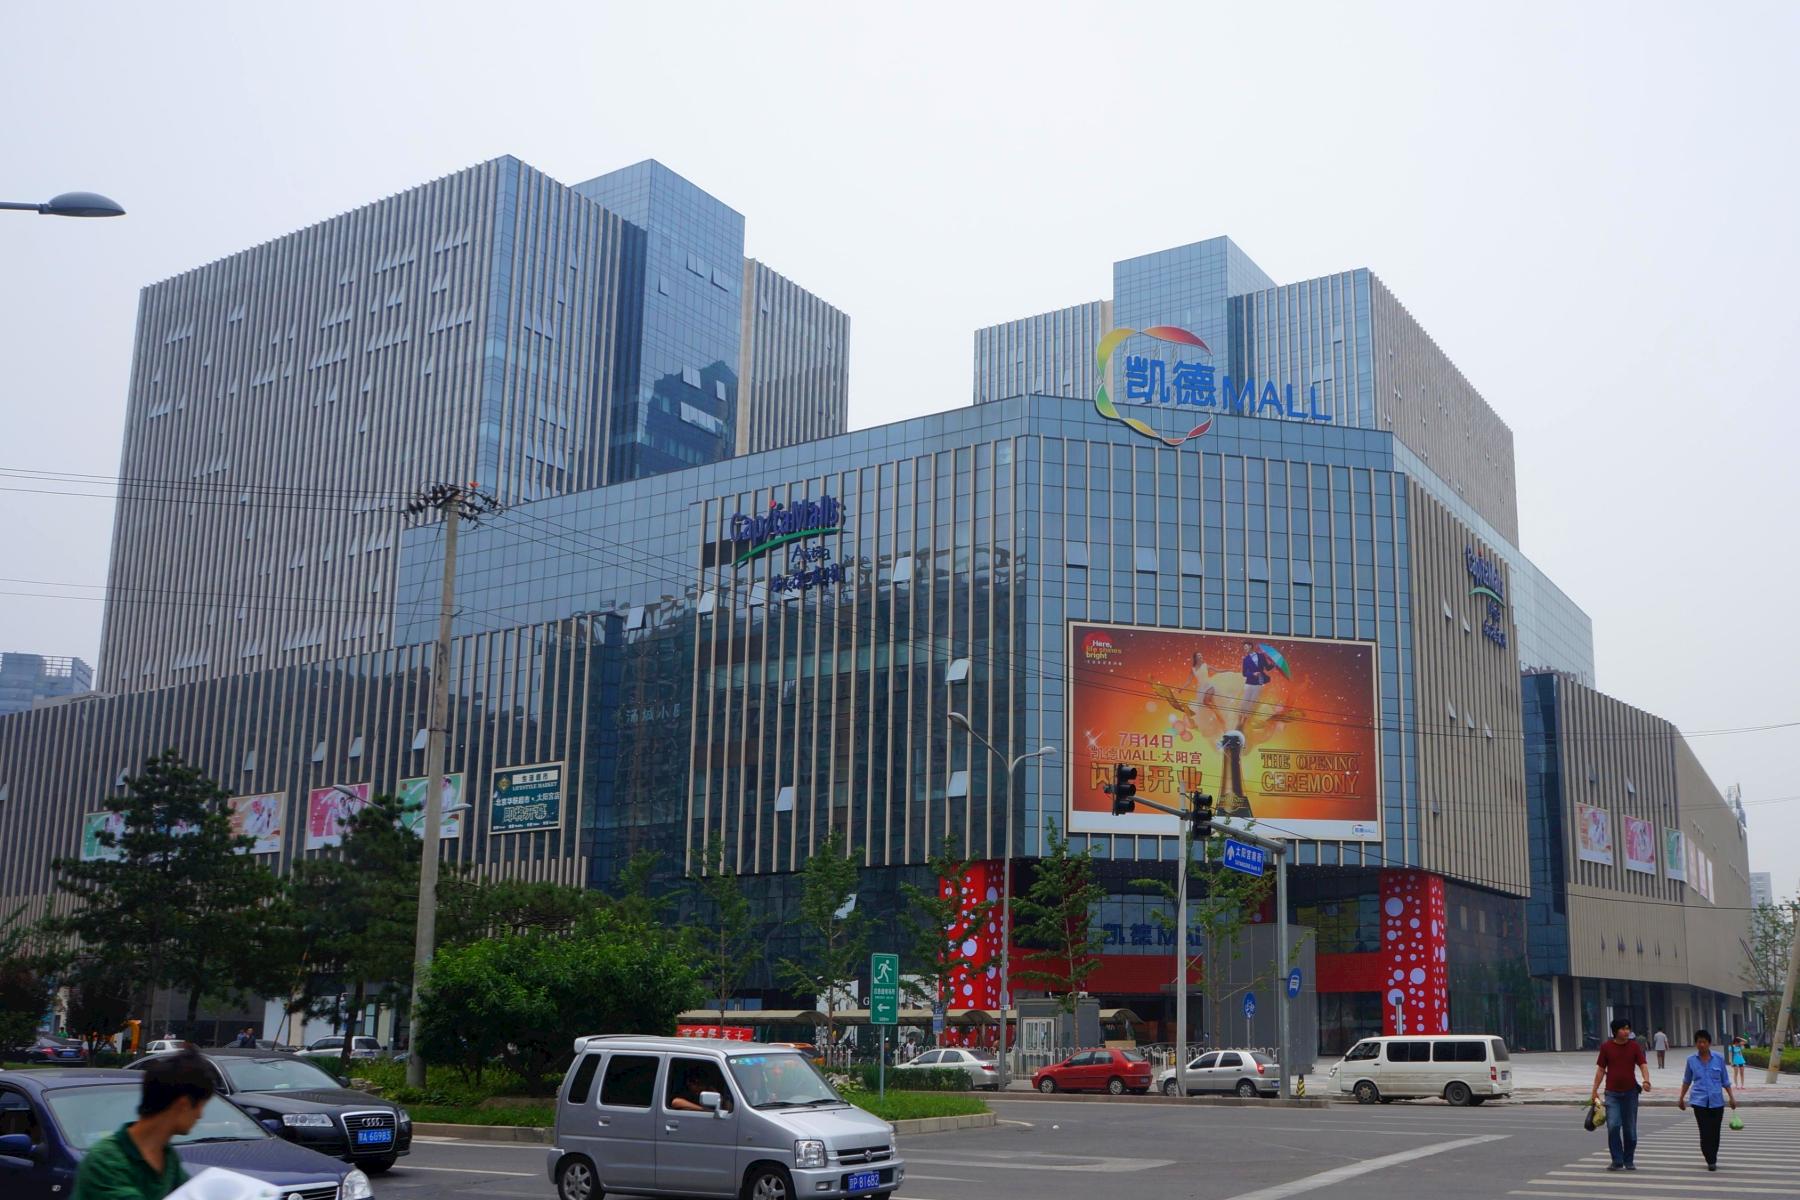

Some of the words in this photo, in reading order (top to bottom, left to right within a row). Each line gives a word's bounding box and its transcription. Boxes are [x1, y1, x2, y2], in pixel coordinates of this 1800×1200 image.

[1125, 356, 1331, 421] 凯德MALL
[1086, 651, 1107, 660] bright
[1119, 732, 1173, 749] 7月14日
[1261, 752, 1291, 769] THE
[1296, 753, 1359, 772] OPENING
[1262, 771, 1360, 794] CEREMONY
